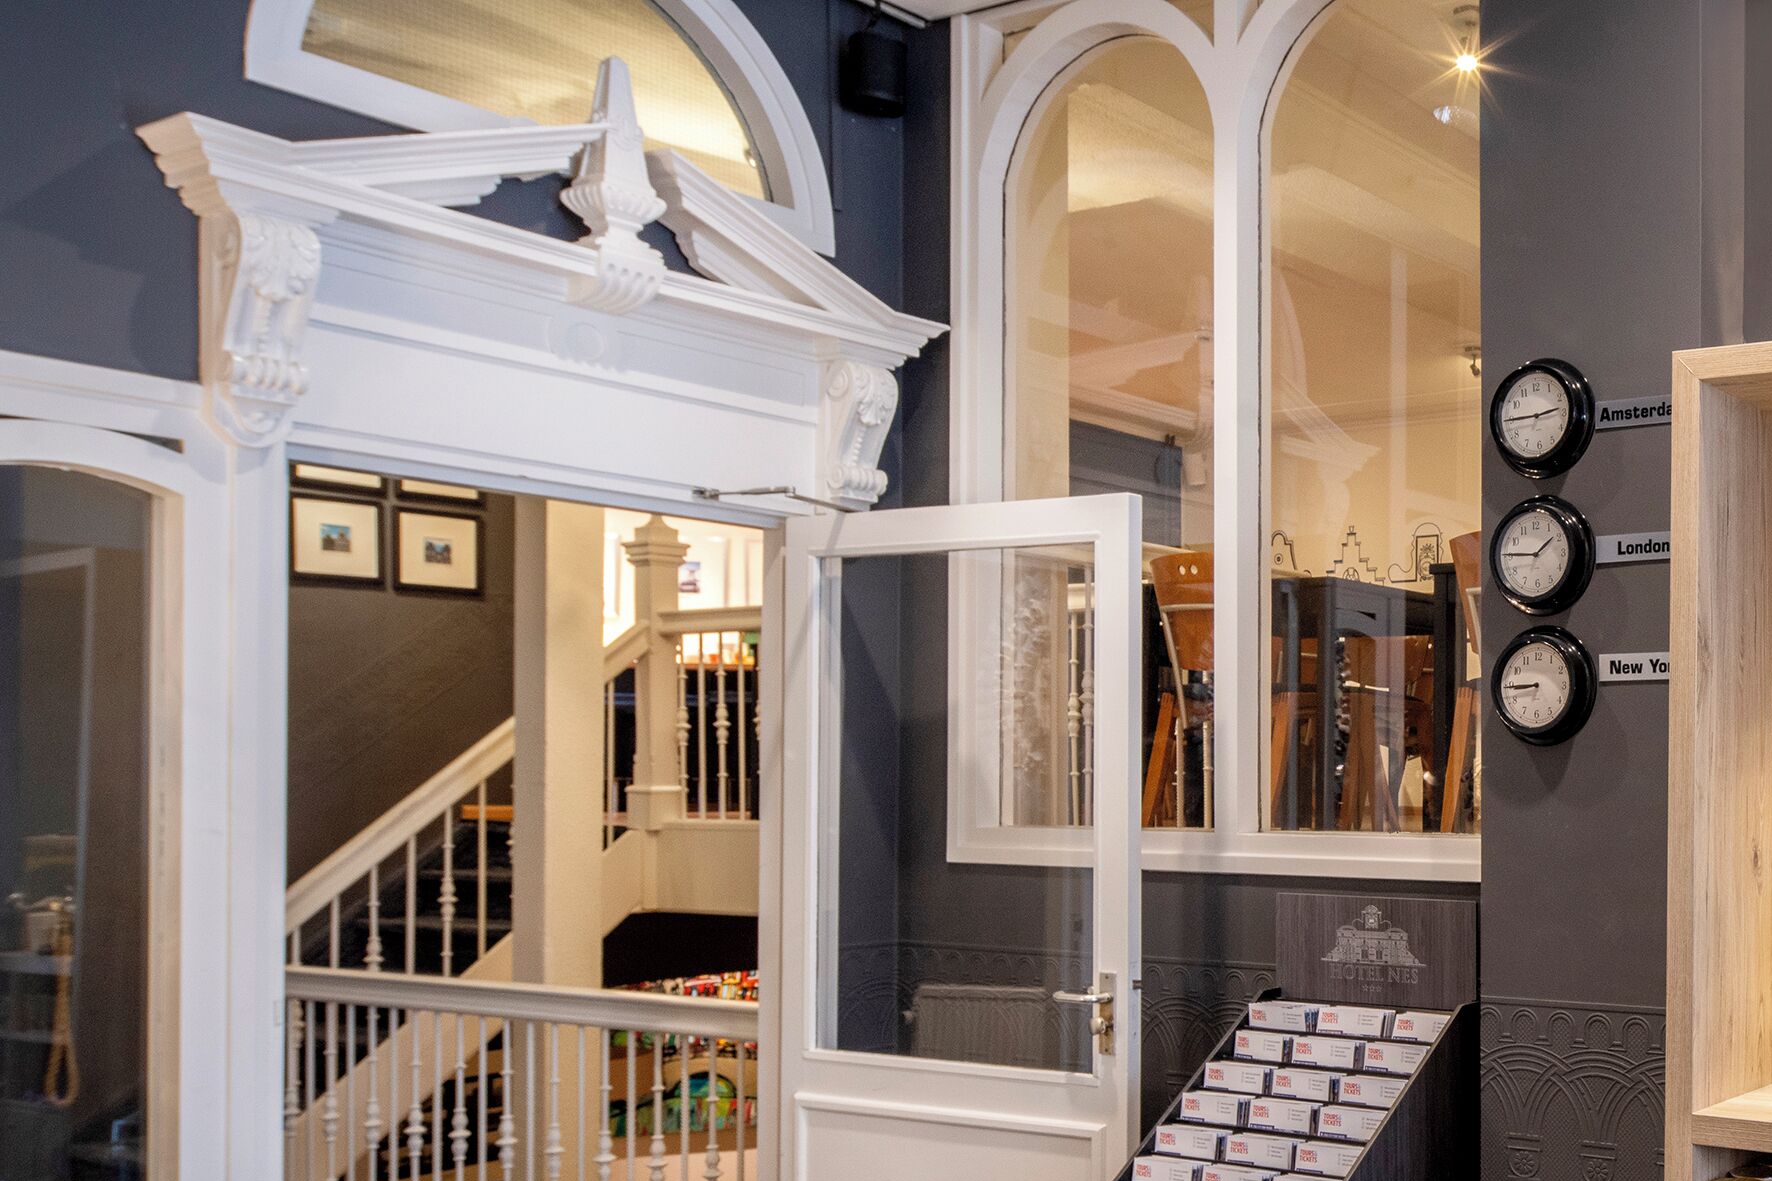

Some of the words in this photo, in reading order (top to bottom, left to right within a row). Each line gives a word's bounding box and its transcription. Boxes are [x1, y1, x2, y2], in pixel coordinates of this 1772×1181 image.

[1532, 383, 1540, 392] 12
[1521, 388, 1527, 397] 11
[1557, 393, 1562, 402] 2
[1513, 400, 1520, 409] 10
[1562, 408, 1567, 417] 3
[1600, 402, 1672, 422] Amsterda
[1558, 424, 1564, 432] 4
[1514, 430, 1519, 438] 8
[1525, 439, 1529, 447] 7
[1537, 440, 1543, 449] 6
[1550, 435, 1555, 445] 5
[1532, 521, 1540, 530] 12
[1521, 526, 1527, 536] 11
[1512, 537, 1519, 546] 10
[1556, 533, 1562, 542] 2
[1617, 539, 1670, 555] London
[1561, 548, 1566, 557] 3
[1513, 567, 1518, 575] 8
[1556, 563, 1562, 572] 4
[1523, 576, 1527, 585] 7
[1535, 578, 1540, 588] 6
[1548, 575, 1554, 584] 5
[1523, 656, 1529, 665] 11
[1534, 652, 1543, 661] 12
[1514, 666, 1521, 675] 10
[1558, 665, 1563, 674] 2
[1609, 660, 1643, 674] New
[1649, 658, 1670, 673] Yo
[1562, 681, 1567, 690] 3
[1512, 696, 1518, 704] 8
[1557, 696, 1562, 704] 4
[1522, 706, 1527, 714] 7
[1534, 709, 1539, 718] 6
[1547, 707, 1553, 715] 5
[1329, 963, 1384, 981] HOTEL
[1387, 967, 1418, 984] NES
